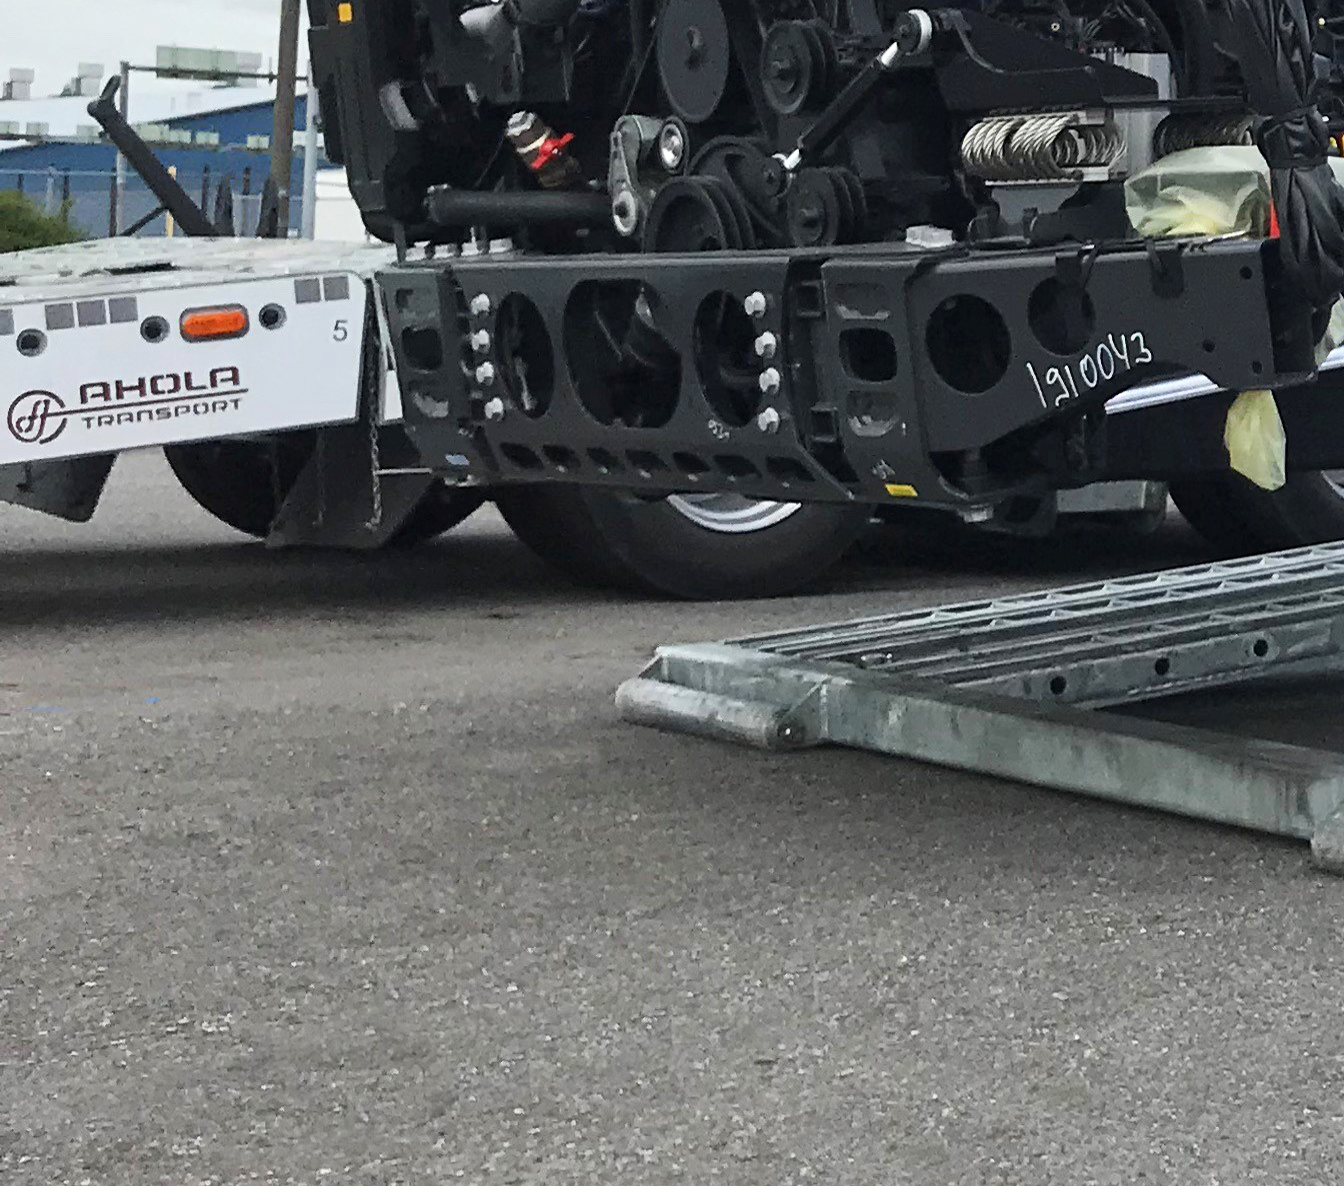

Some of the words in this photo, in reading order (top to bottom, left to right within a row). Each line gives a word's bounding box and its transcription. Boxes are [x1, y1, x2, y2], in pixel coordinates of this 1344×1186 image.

[333, 319, 348, 342] 5
[79, 366, 240, 404] AHOLA
[1026, 332, 1152, 408] 1910043
[81, 398, 242, 430] TRANSPORT
